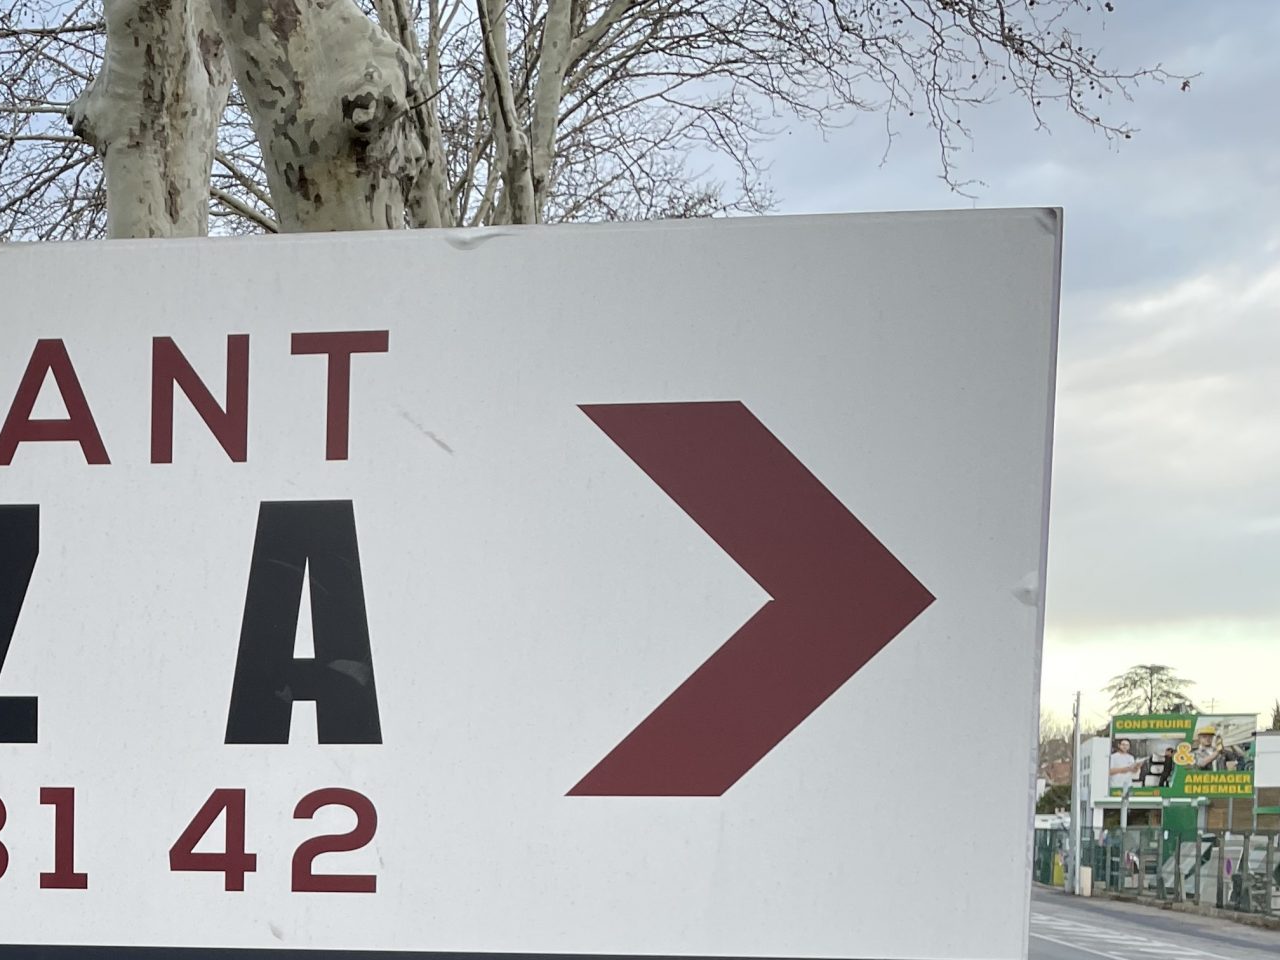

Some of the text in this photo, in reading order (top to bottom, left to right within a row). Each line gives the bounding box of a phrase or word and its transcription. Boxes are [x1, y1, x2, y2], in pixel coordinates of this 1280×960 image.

[1116, 719, 1192, 729] CONSTRUIRE
[1174, 743, 1195, 765] &
[1184, 784, 1252, 794] ENSEMBLE
[169, 788, 377, 893] 42
